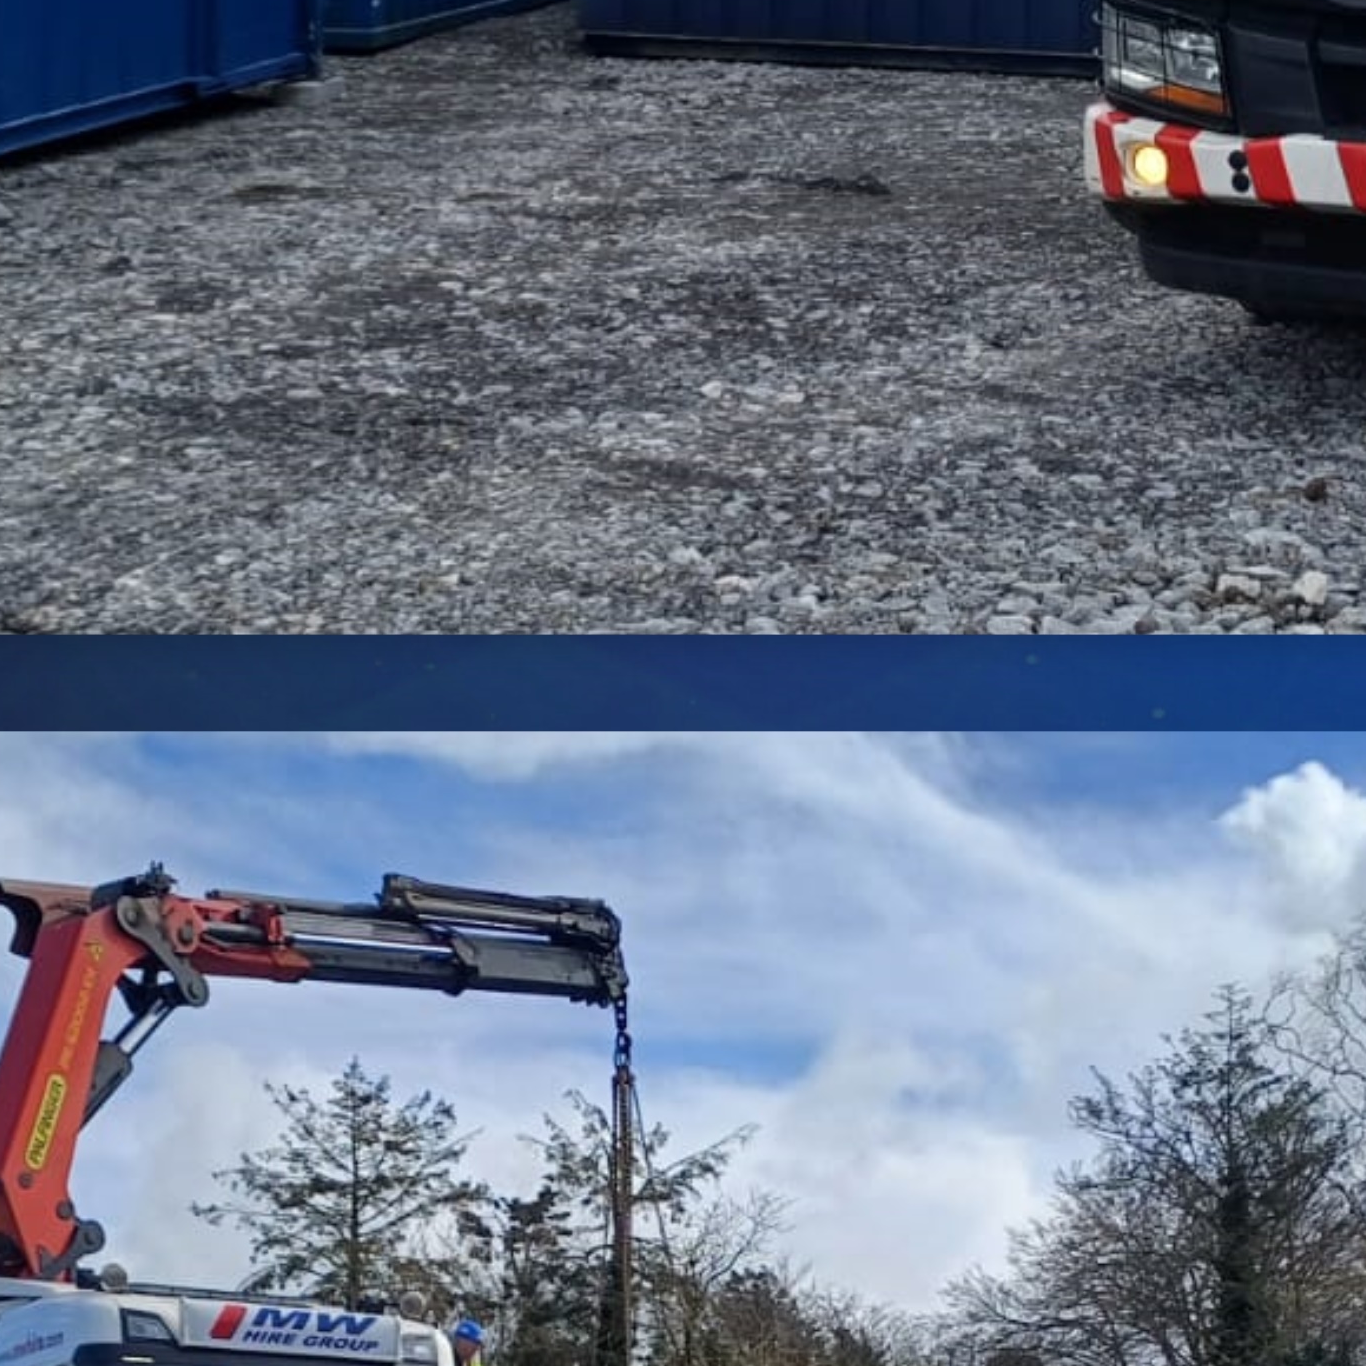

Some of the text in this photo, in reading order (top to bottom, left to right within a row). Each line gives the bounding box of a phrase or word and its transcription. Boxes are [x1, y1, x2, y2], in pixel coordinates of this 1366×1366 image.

[252, 1306, 379, 1336] MW
[242, 1330, 379, 1352] HIRE GROUP
